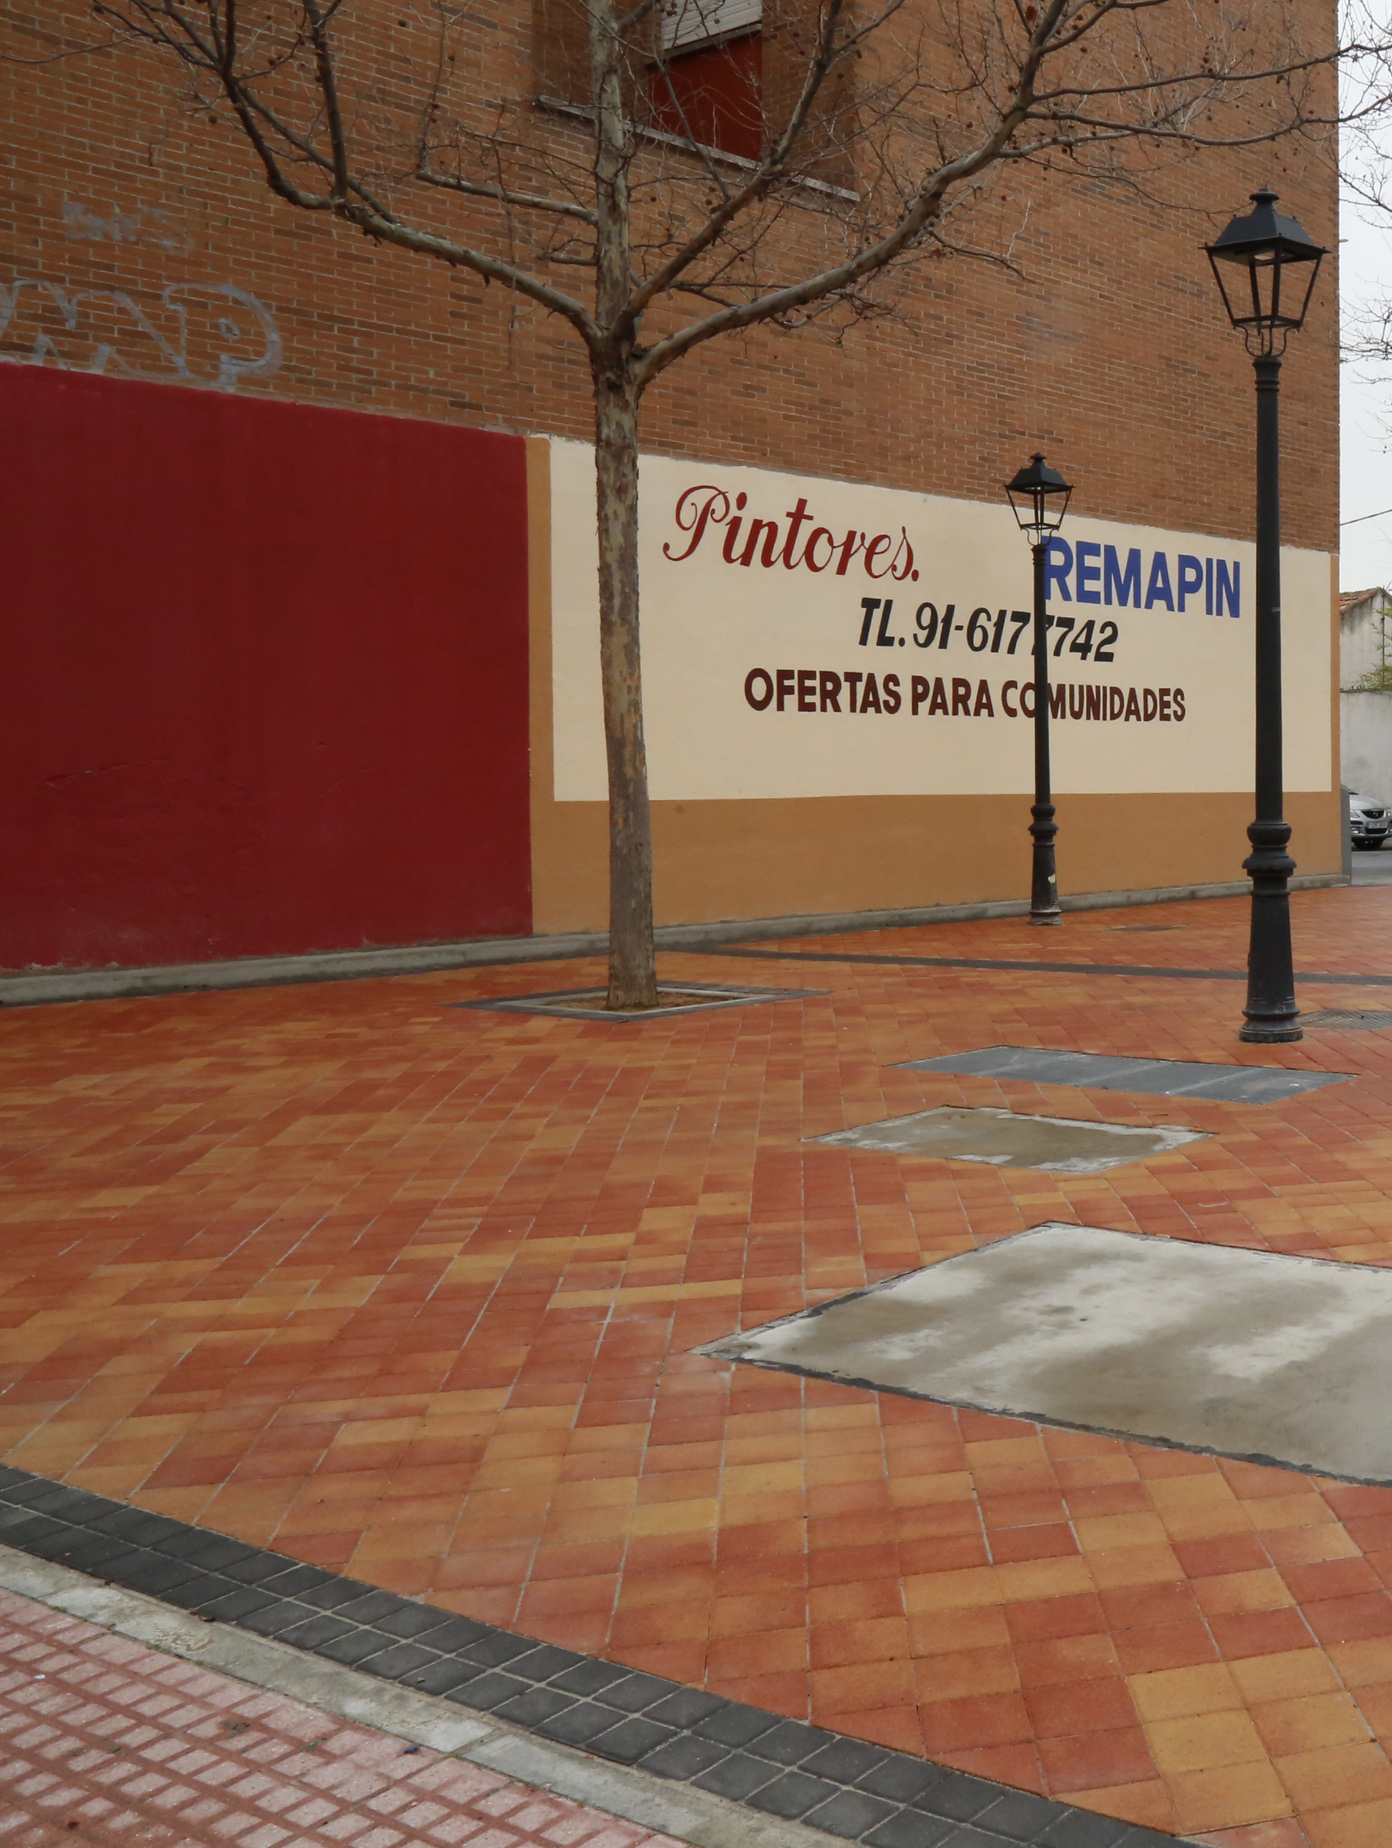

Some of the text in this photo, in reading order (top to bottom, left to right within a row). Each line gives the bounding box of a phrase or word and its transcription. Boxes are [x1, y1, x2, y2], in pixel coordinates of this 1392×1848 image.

[663, 485, 919, 581] Pintores.
[1041, 536, 1240, 618] REMAPIN
[858, 597, 906, 648] TL.
[744, 667, 1186, 722] OFERTAS PARA COMUNIDADES
